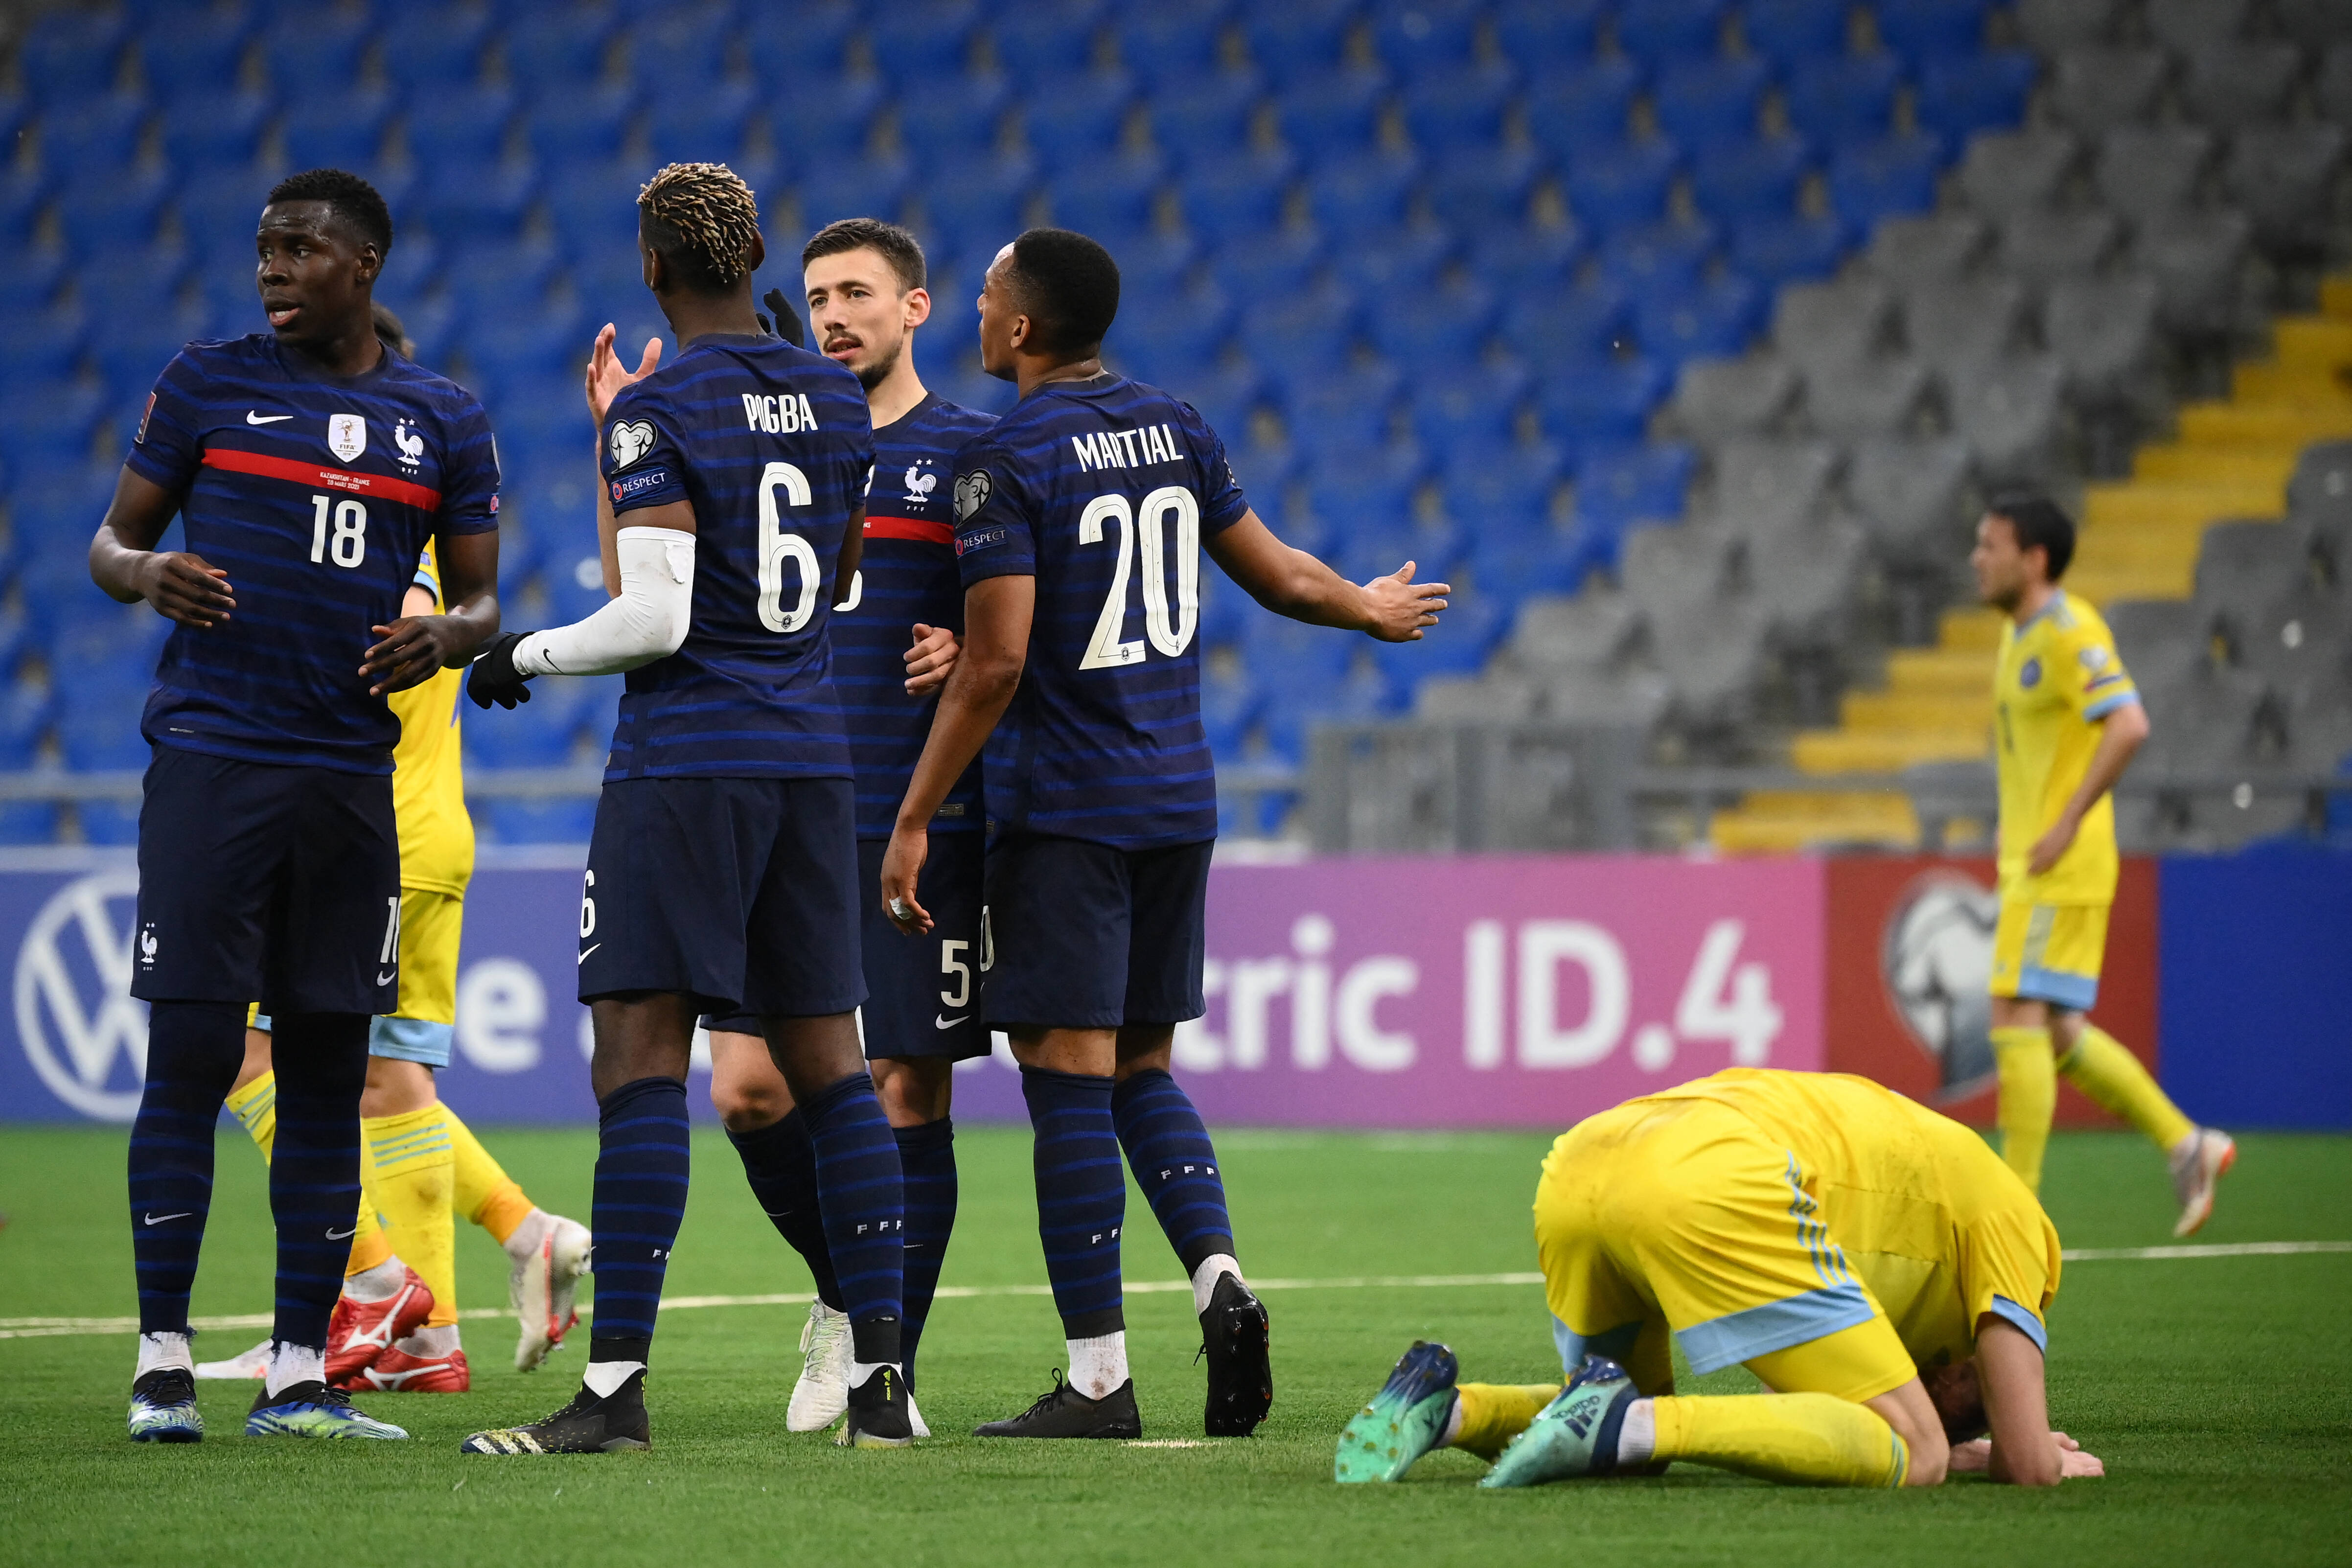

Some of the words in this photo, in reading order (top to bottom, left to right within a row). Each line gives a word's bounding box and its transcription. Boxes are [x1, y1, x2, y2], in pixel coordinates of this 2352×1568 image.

[742, 393, 818, 434] POGBA
[1072, 424, 1184, 473] MARTIAL
[353, 477, 370, 486] FRANCE
[622, 472, 665, 493] RESPECT
[311, 495, 367, 568] 18
[758, 461, 820, 633] 6
[963, 530, 1006, 549] RESPECT
[1079, 486, 1199, 670] 20
[580, 869, 596, 938] 6
[941, 939, 970, 1007] 5
[1463, 918, 1784, 1071] ID.4
[1550, 1395, 1600, 1419] adidas
